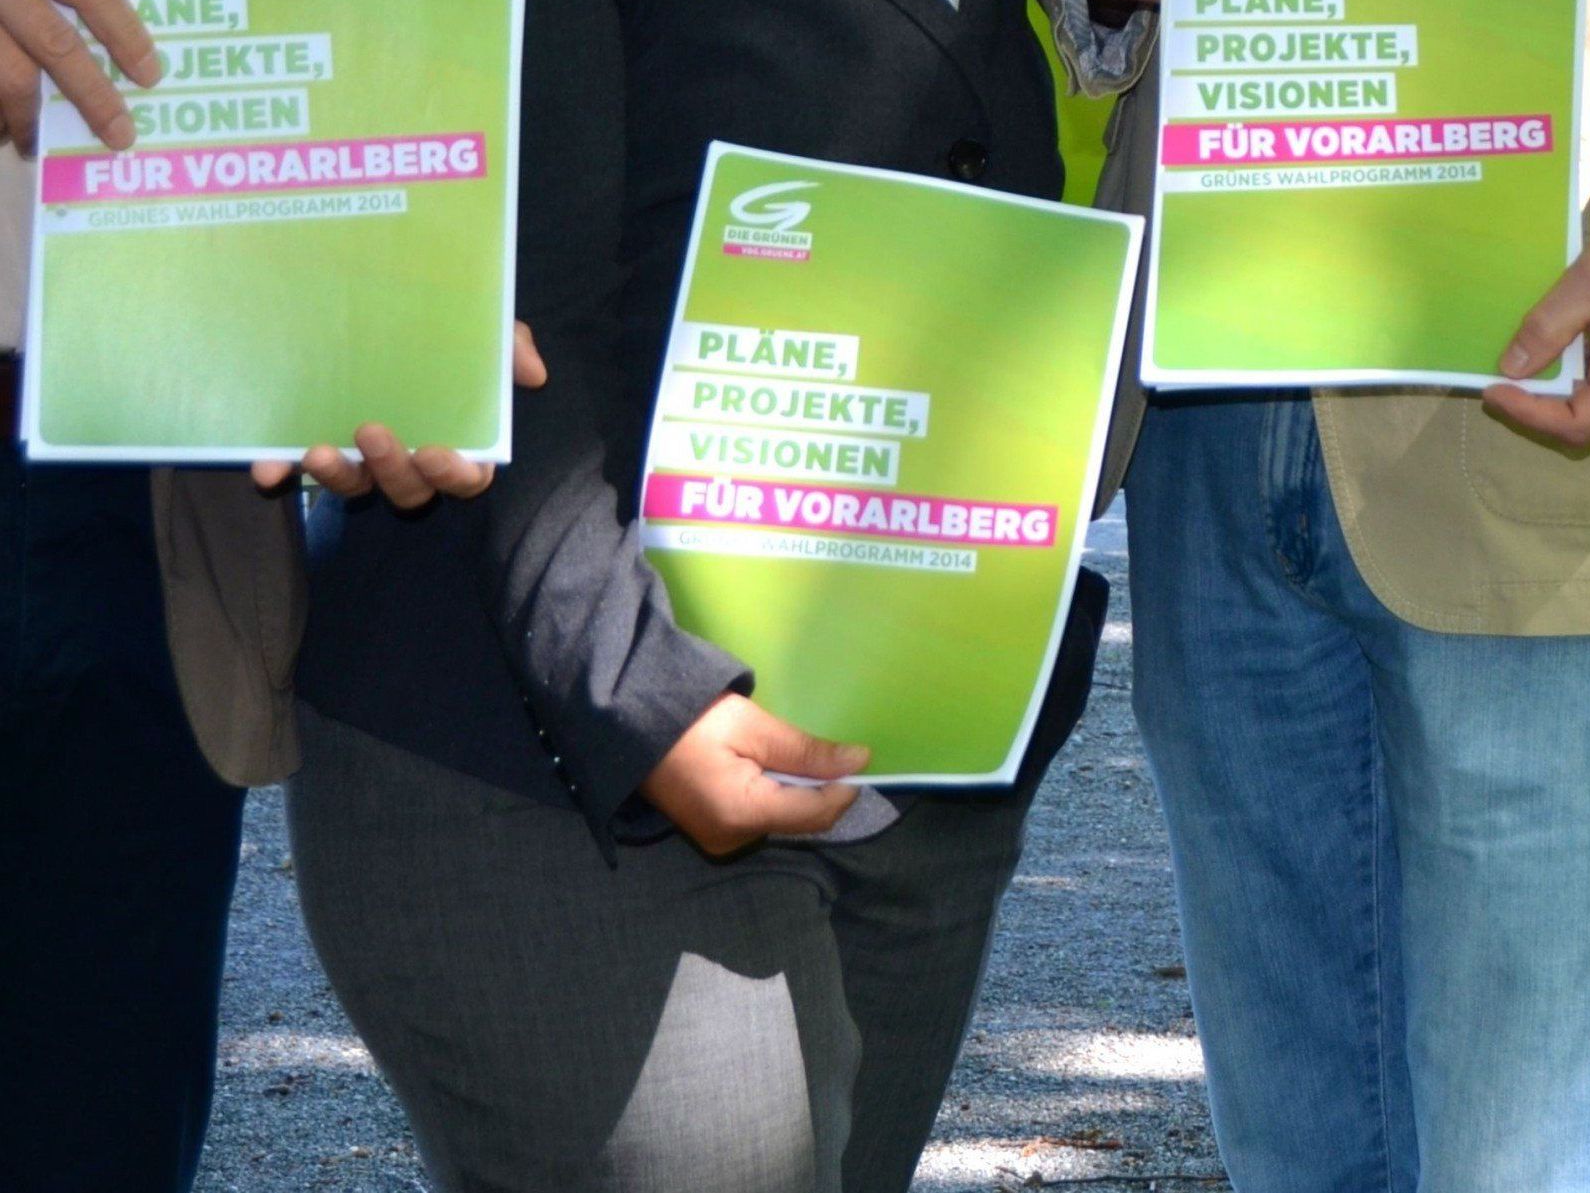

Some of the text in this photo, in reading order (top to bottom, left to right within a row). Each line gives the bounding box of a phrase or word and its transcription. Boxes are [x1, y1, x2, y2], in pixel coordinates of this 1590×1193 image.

[92, 42, 325, 81] JEKTE,
[1196, 33, 1411, 64] PROJEKTE,
[1199, 79, 1389, 111] VISIONEN
[92, 96, 300, 138] SIONEN
[1200, 120, 1546, 160] FÜR VORARLBERG
[84, 139, 478, 194] FÜR VORARLBERG
[1201, 163, 1477, 188] GRÜNES WAHLPROGRAMM 2014
[88, 192, 403, 229] GRÜNES WAHLPROGRAMM 2014
[727, 228, 809, 245] DIE GRÜNEN
[699, 329, 848, 379] PLÄNE,
[693, 383, 920, 436] PROJEKTE,
[689, 433, 892, 478] VISIONEN
[681, 479, 765, 519] FÜR
[773, 489, 1051, 542] VORARLBERG
[929, 551, 972, 569] 2014
